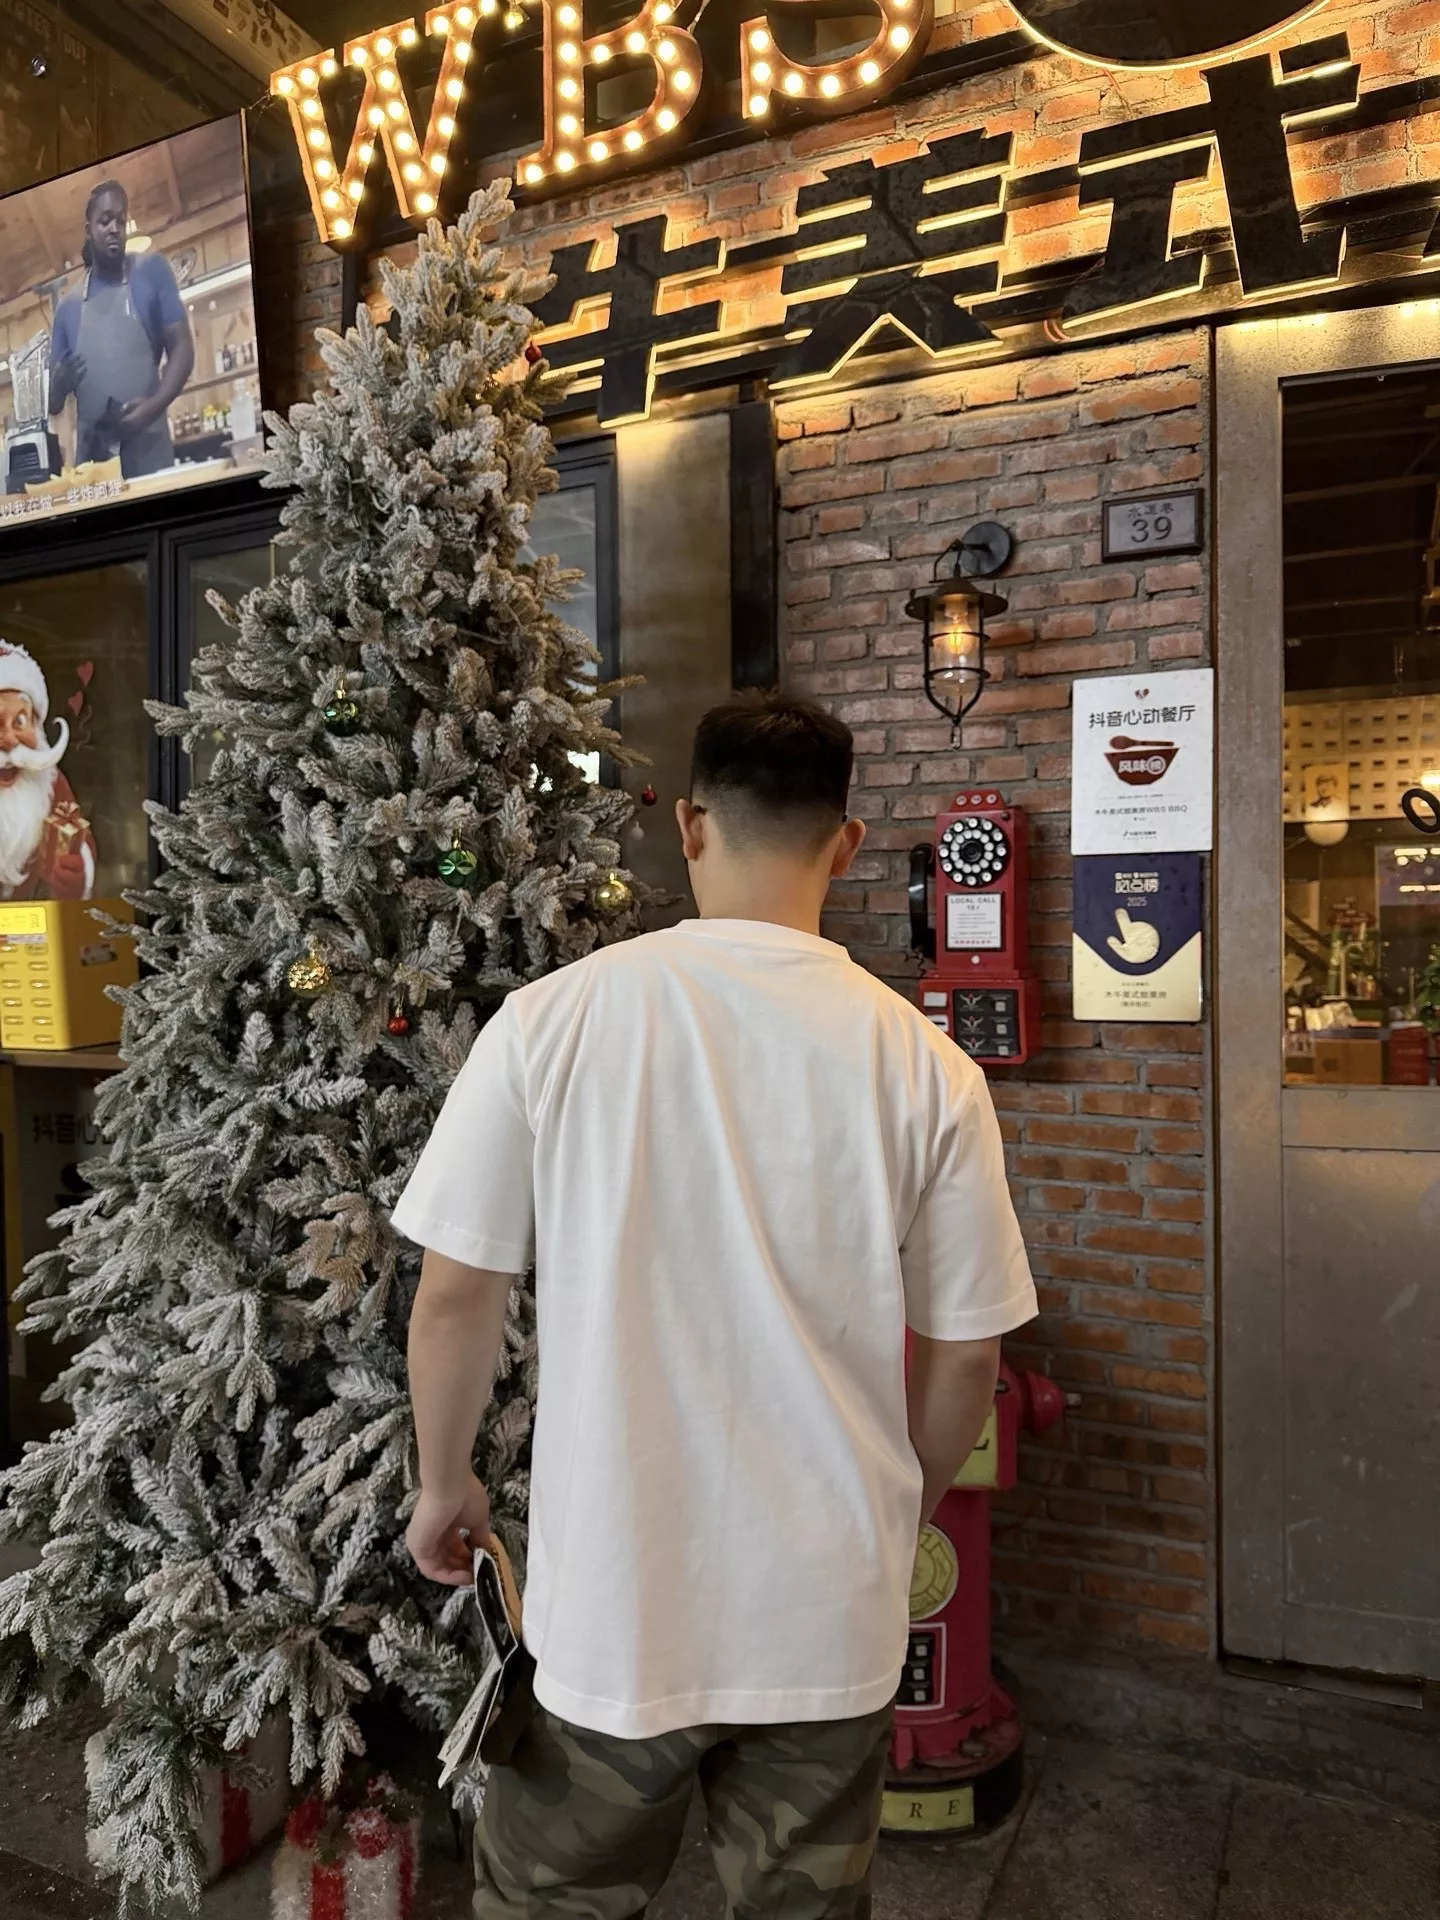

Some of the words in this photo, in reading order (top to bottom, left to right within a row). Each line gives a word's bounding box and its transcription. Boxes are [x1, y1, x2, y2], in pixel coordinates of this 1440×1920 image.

[1131, 516, 1172, 543] 39
[1089, 704, 1196, 729] 抖音心动餐厅
[1115, 879, 1158, 893] 必点榜
[977, 896, 997, 904] CALL
